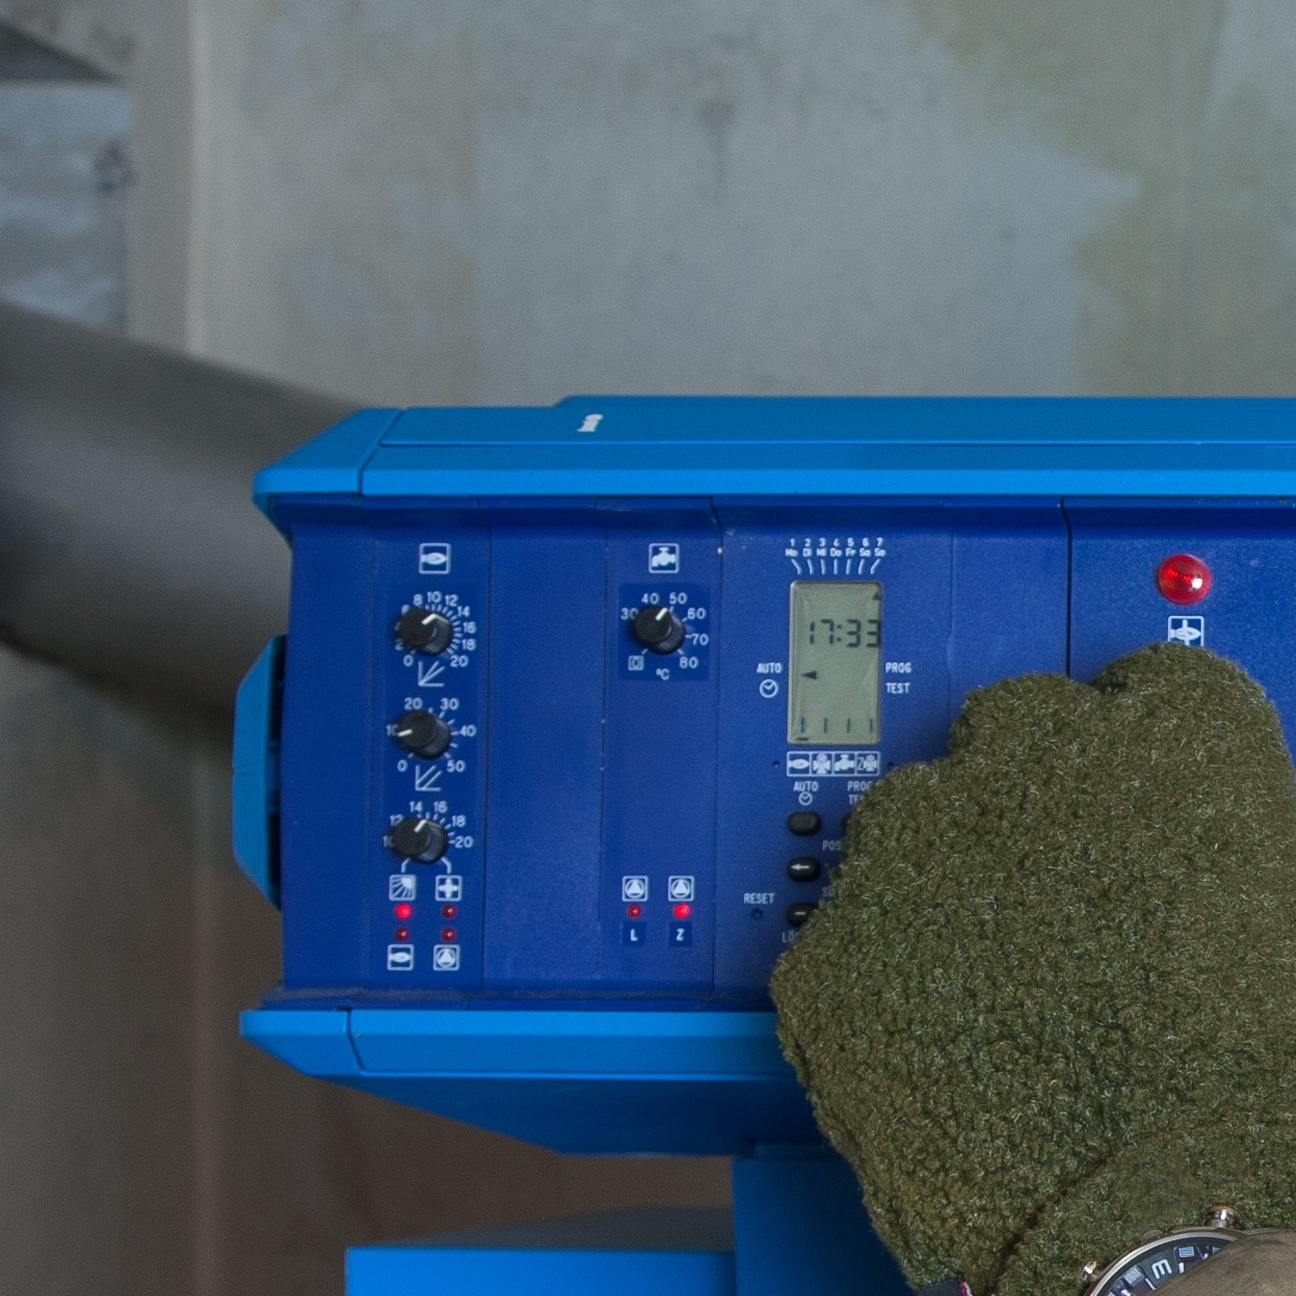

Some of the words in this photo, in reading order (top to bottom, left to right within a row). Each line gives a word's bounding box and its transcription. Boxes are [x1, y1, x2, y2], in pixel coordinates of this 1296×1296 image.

[804, 538, 811, 547] 2
[819, 538, 826, 547] 3
[847, 538, 854, 547] 5
[862, 538, 869, 547] 6
[876, 537, 883, 547] 7
[829, 547, 842, 557] Do
[845, 547, 856, 557] Fr
[859, 547, 871, 557] Sa
[874, 547, 886, 557] So
[413, 593, 423, 606] 8
[427, 591, 442, 603] 10
[445, 594, 459, 607] 12
[641, 592, 660, 605] 40
[669, 592, 688, 605] 50
[457, 605, 470, 618] 14
[687, 607, 707, 620] 60
[463, 621, 477, 634] 16
[809, 618, 881, 648] 17:33
[462, 638, 476, 651] 18
[692, 633, 709, 646] 70
[403, 654, 414, 667] 0
[450, 655, 469, 668] 20
[679, 656, 699, 669] 80
[885, 661, 912, 673] PROG
[756, 662, 783, 674] AUTO
[885, 682, 911, 694] TEST
[404, 697, 423, 711] 20
[440, 697, 459, 711] 30
[459, 724, 477, 737] 40
[397, 760, 408, 772] 0
[446, 759, 466, 773] 50
[793, 781, 819, 792] AUTO
[409, 801, 422, 813] 14
[433, 800, 448, 813] 16
[452, 815, 467, 828] 18
[454, 836, 474, 849] 20
[743, 893, 775, 904] RESET
[630, 928, 638, 942] L
[676, 928, 684, 942] Z
